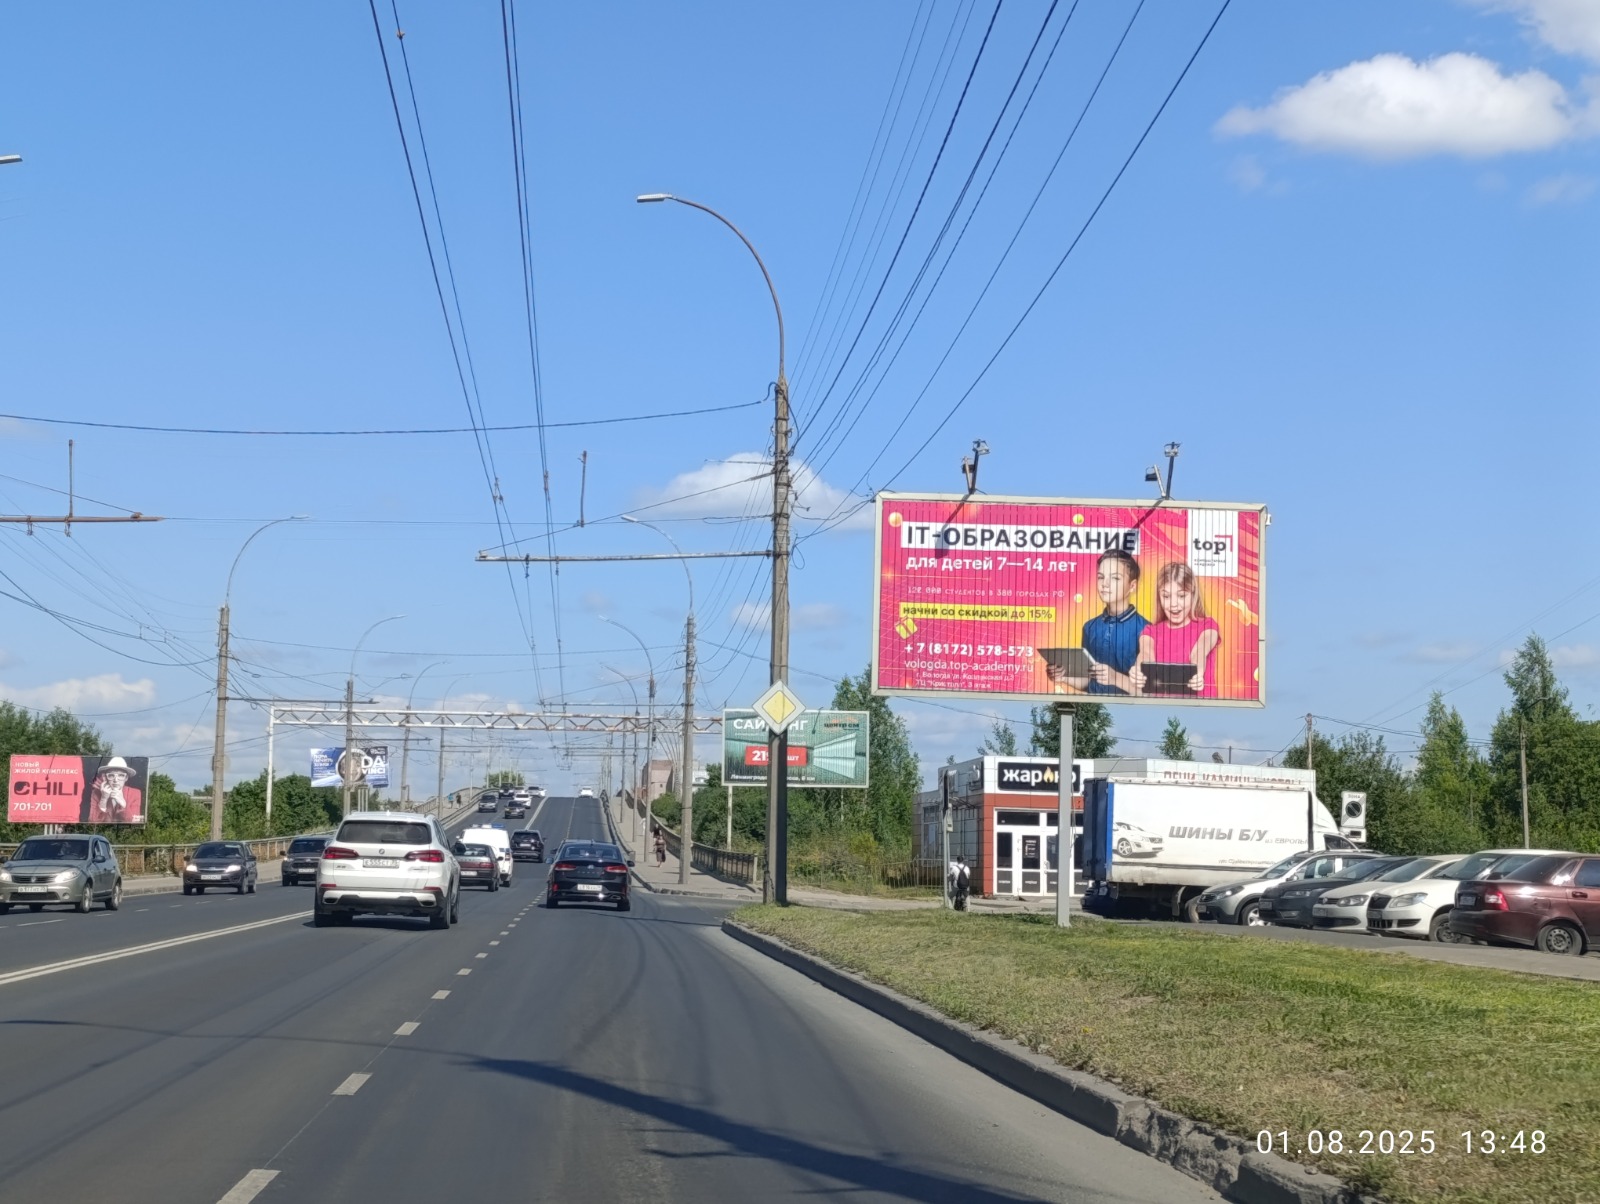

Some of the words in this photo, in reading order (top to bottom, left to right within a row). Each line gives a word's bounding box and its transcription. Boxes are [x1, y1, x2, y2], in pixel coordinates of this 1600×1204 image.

[907, 526, 1136, 551] IT-ОБРАЗОВАНИЕ
[1193, 538, 1226, 555] top
[906, 556, 938, 570] для
[941, 556, 993, 572] детей
[1047, 560, 1077, 573] лет
[903, 606, 938, 615] начни
[941, 607, 955, 616] со
[957, 607, 1008, 619] скидкой
[1010, 610, 1025, 620] до
[1029, 609, 1053, 619] 15%
[916, 643, 926, 654] 7
[928, 643, 973, 657] (8172)
[976, 644, 1034, 657] 578-573
[904, 658, 1034, 674] vologda.top-academy.ru
[733, 717, 809, 731] САЙНГ
[13, 802, 52, 811] 701-701
[1168, 826, 1233, 840] ШИНЫ
[1238, 829, 1269, 842] Б/У
